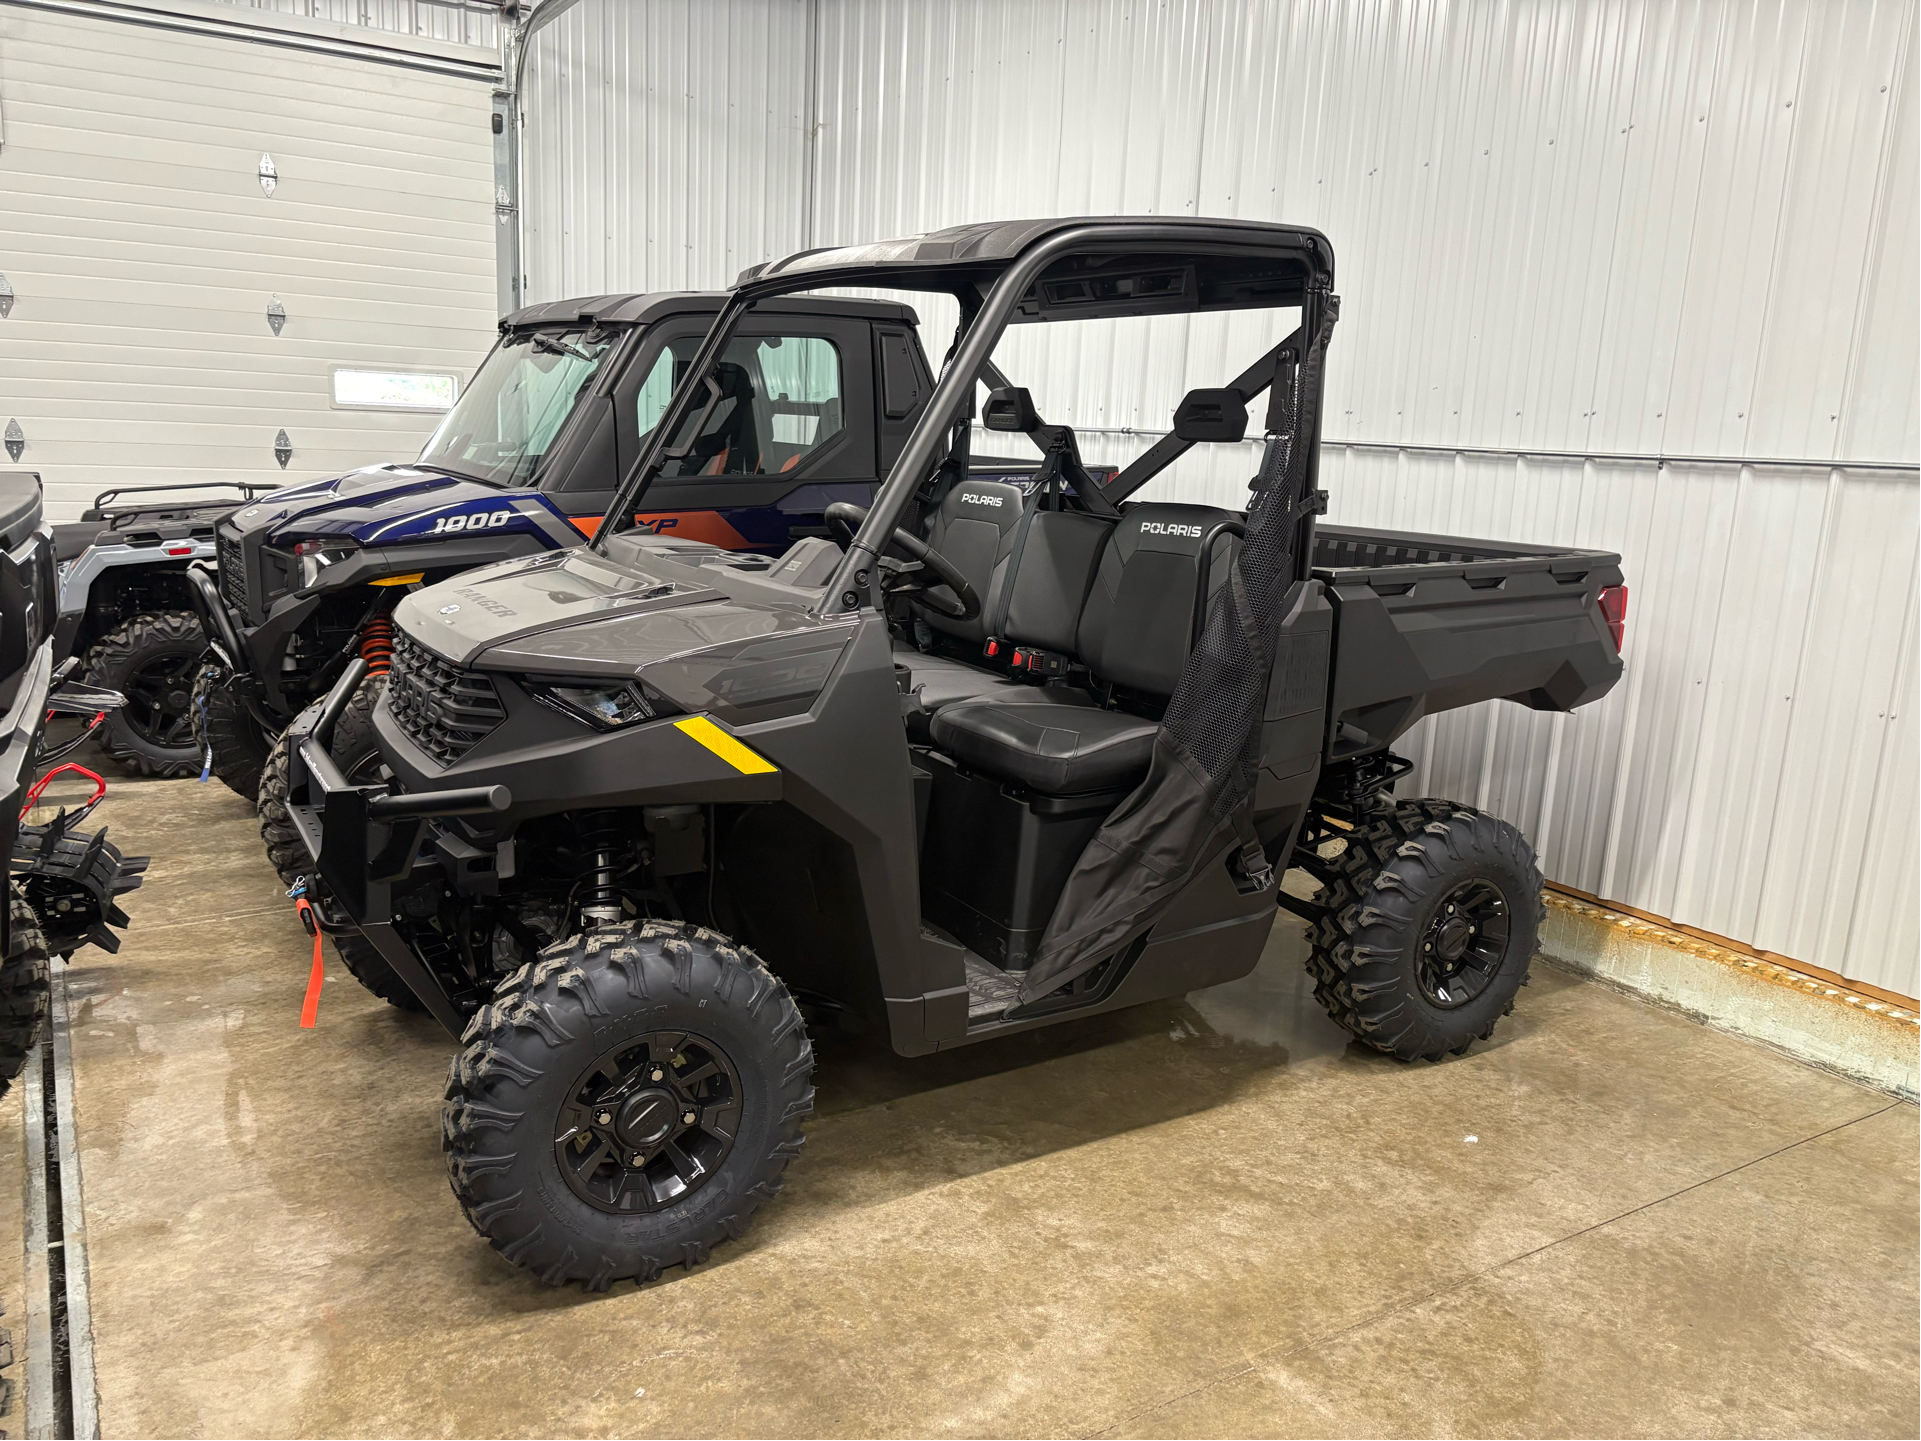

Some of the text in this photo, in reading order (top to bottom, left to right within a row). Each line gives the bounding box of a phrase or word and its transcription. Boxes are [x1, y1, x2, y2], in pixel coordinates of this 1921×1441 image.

[961, 492, 1003, 508] POLARIS
[434, 510, 511, 535] 1000
[1140, 521, 1202, 538] POLARIS
[453, 588, 518, 619] RANGER
[624, 1188, 730, 1246] CARLSTAR
